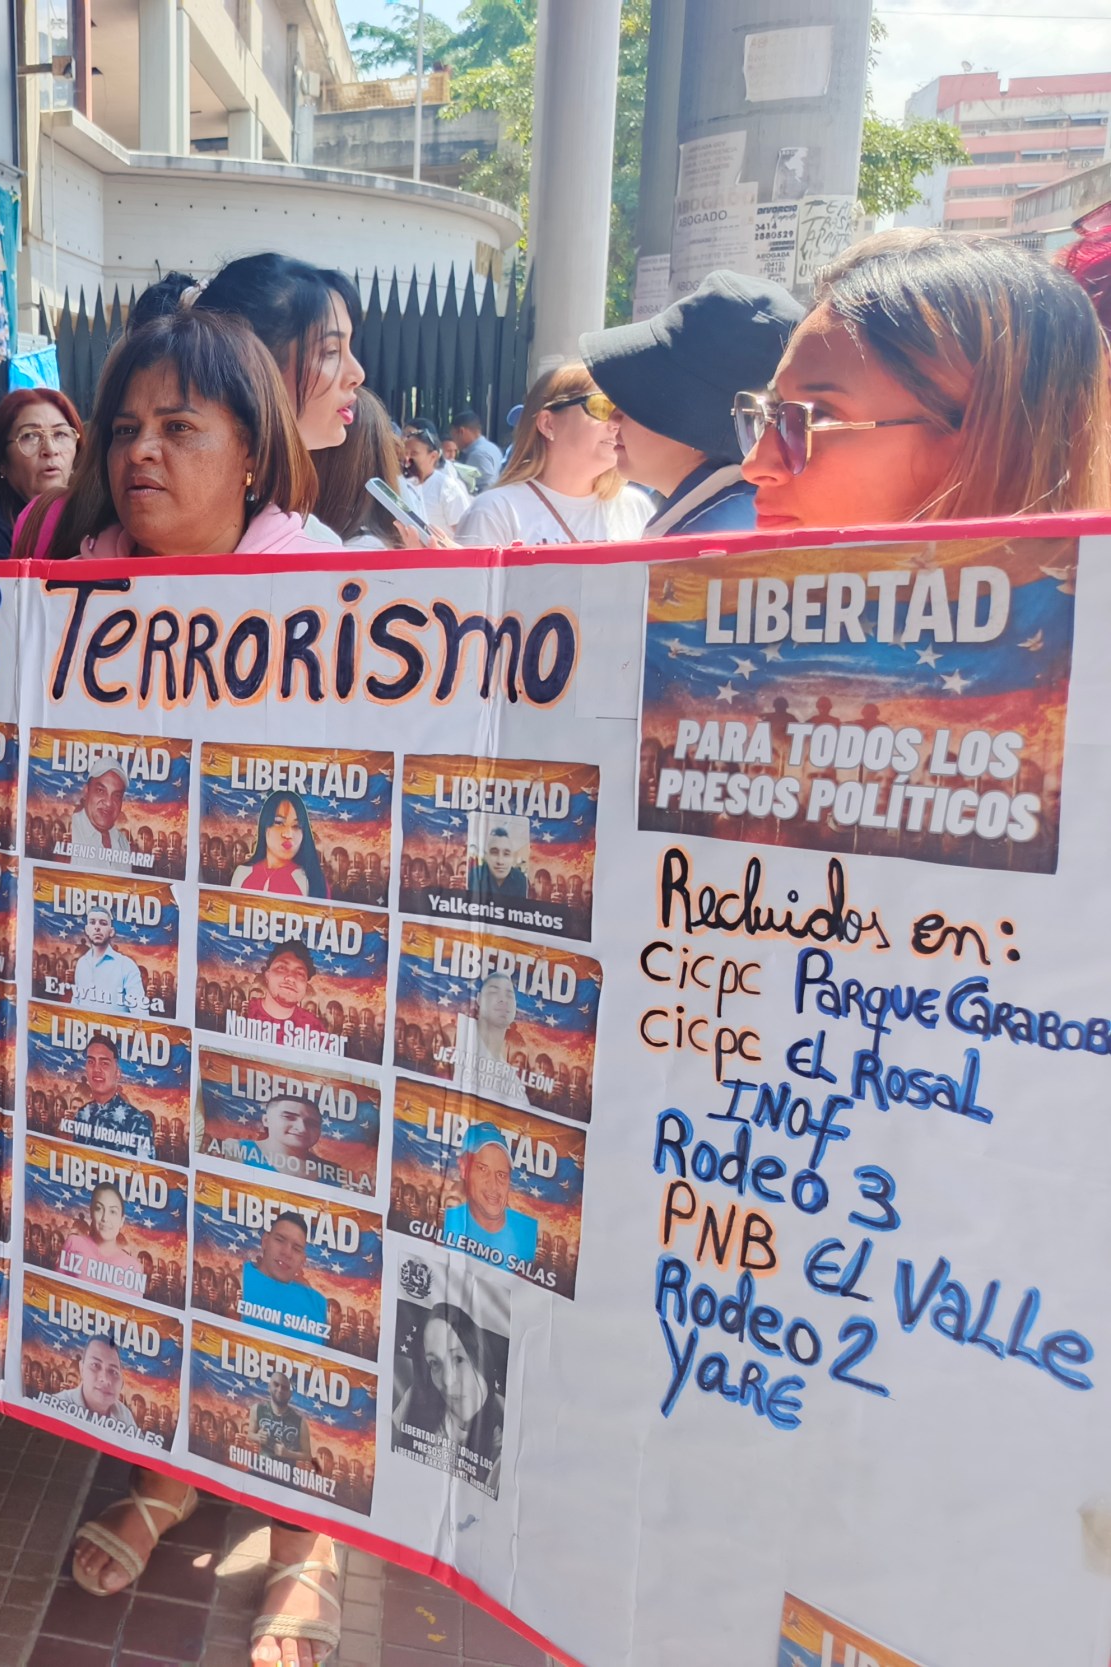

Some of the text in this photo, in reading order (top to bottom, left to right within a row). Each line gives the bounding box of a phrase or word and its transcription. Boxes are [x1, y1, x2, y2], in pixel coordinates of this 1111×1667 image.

[679, 210, 727, 227] ABOGADO
[757, 205, 798, 215] DIVORCIO
[705, 566, 1012, 644] LIBERTAD
[674, 719, 1024, 780] PARA TODOS LOS
[230, 755, 369, 800] LIBERTAD
[434, 774, 570, 820] LIBERTAD
[655, 768, 1042, 843] PRESOS POLÍTICOS
[53, 841, 154, 869] ALBENIS URRIBARRI
[228, 903, 363, 956] LIBERTAD
[428, 894, 563, 930] Yalkenis matos
[44, 976, 113, 1004] Erwin
[225, 1008, 348, 1058] Nomar Salazar
[433, 1046, 471, 1067] JEAN
[521, 1068, 554, 1094] LEÓN
[60, 1118, 151, 1151] KEVIN URDANETA
[207, 1137, 373, 1192] ARMANDO PIRELA
[847, 1165, 901, 1232] 3
[659, 1179, 780, 1276] PNB
[59, 1249, 147, 1295] LIZ RINCÓN
[409, 1220, 557, 1287] GUILLERMO SALAS
[48, 1293, 161, 1358] LIBERTAD
[236, 1299, 331, 1340] EDIXON SUÁREZ
[828, 1313, 893, 1400] 2
[88, 1411, 165, 1449] MORALES
[400, 1422, 436, 1444] LIBERTAD
[480, 1455, 493, 1471] LOS
[413, 1439, 442, 1459] PRESOS
[228, 1445, 336, 1499] GUILLERMO SUÁREZ
[394, 1445, 424, 1464] LIBERTAD
